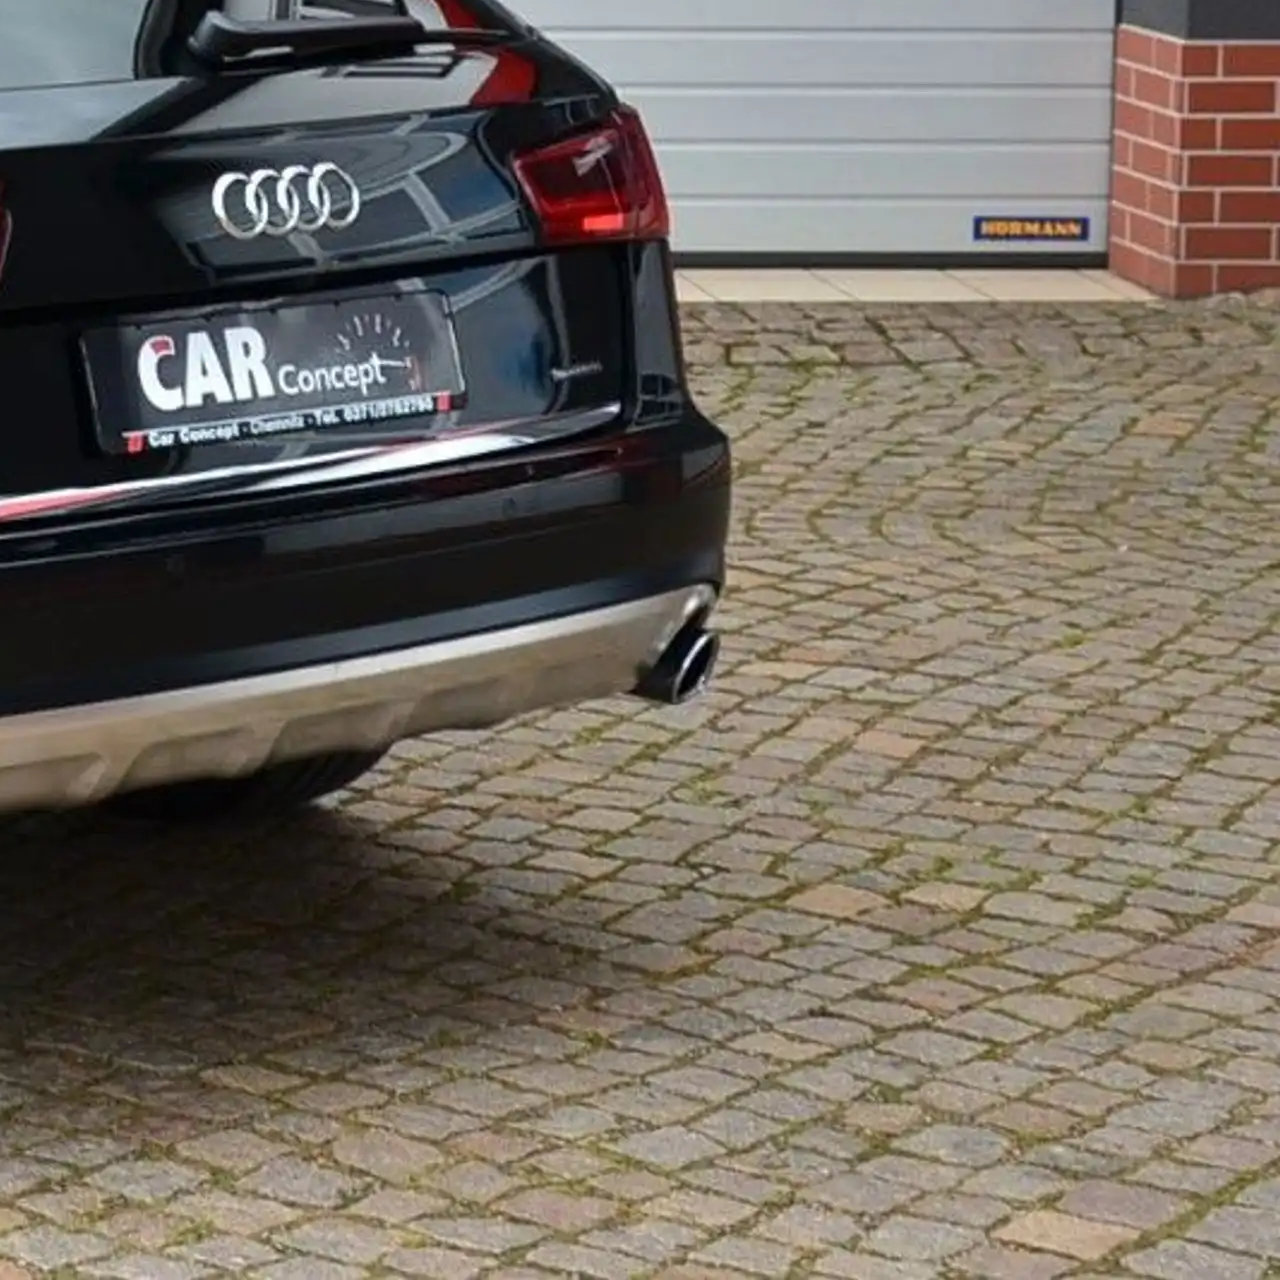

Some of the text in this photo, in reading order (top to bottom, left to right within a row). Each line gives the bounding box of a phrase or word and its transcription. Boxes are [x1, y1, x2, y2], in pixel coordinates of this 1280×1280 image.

[138, 326, 389, 412] CAR Concept
[147, 432, 175, 448] Car
[180, 426, 240, 444] Concept
